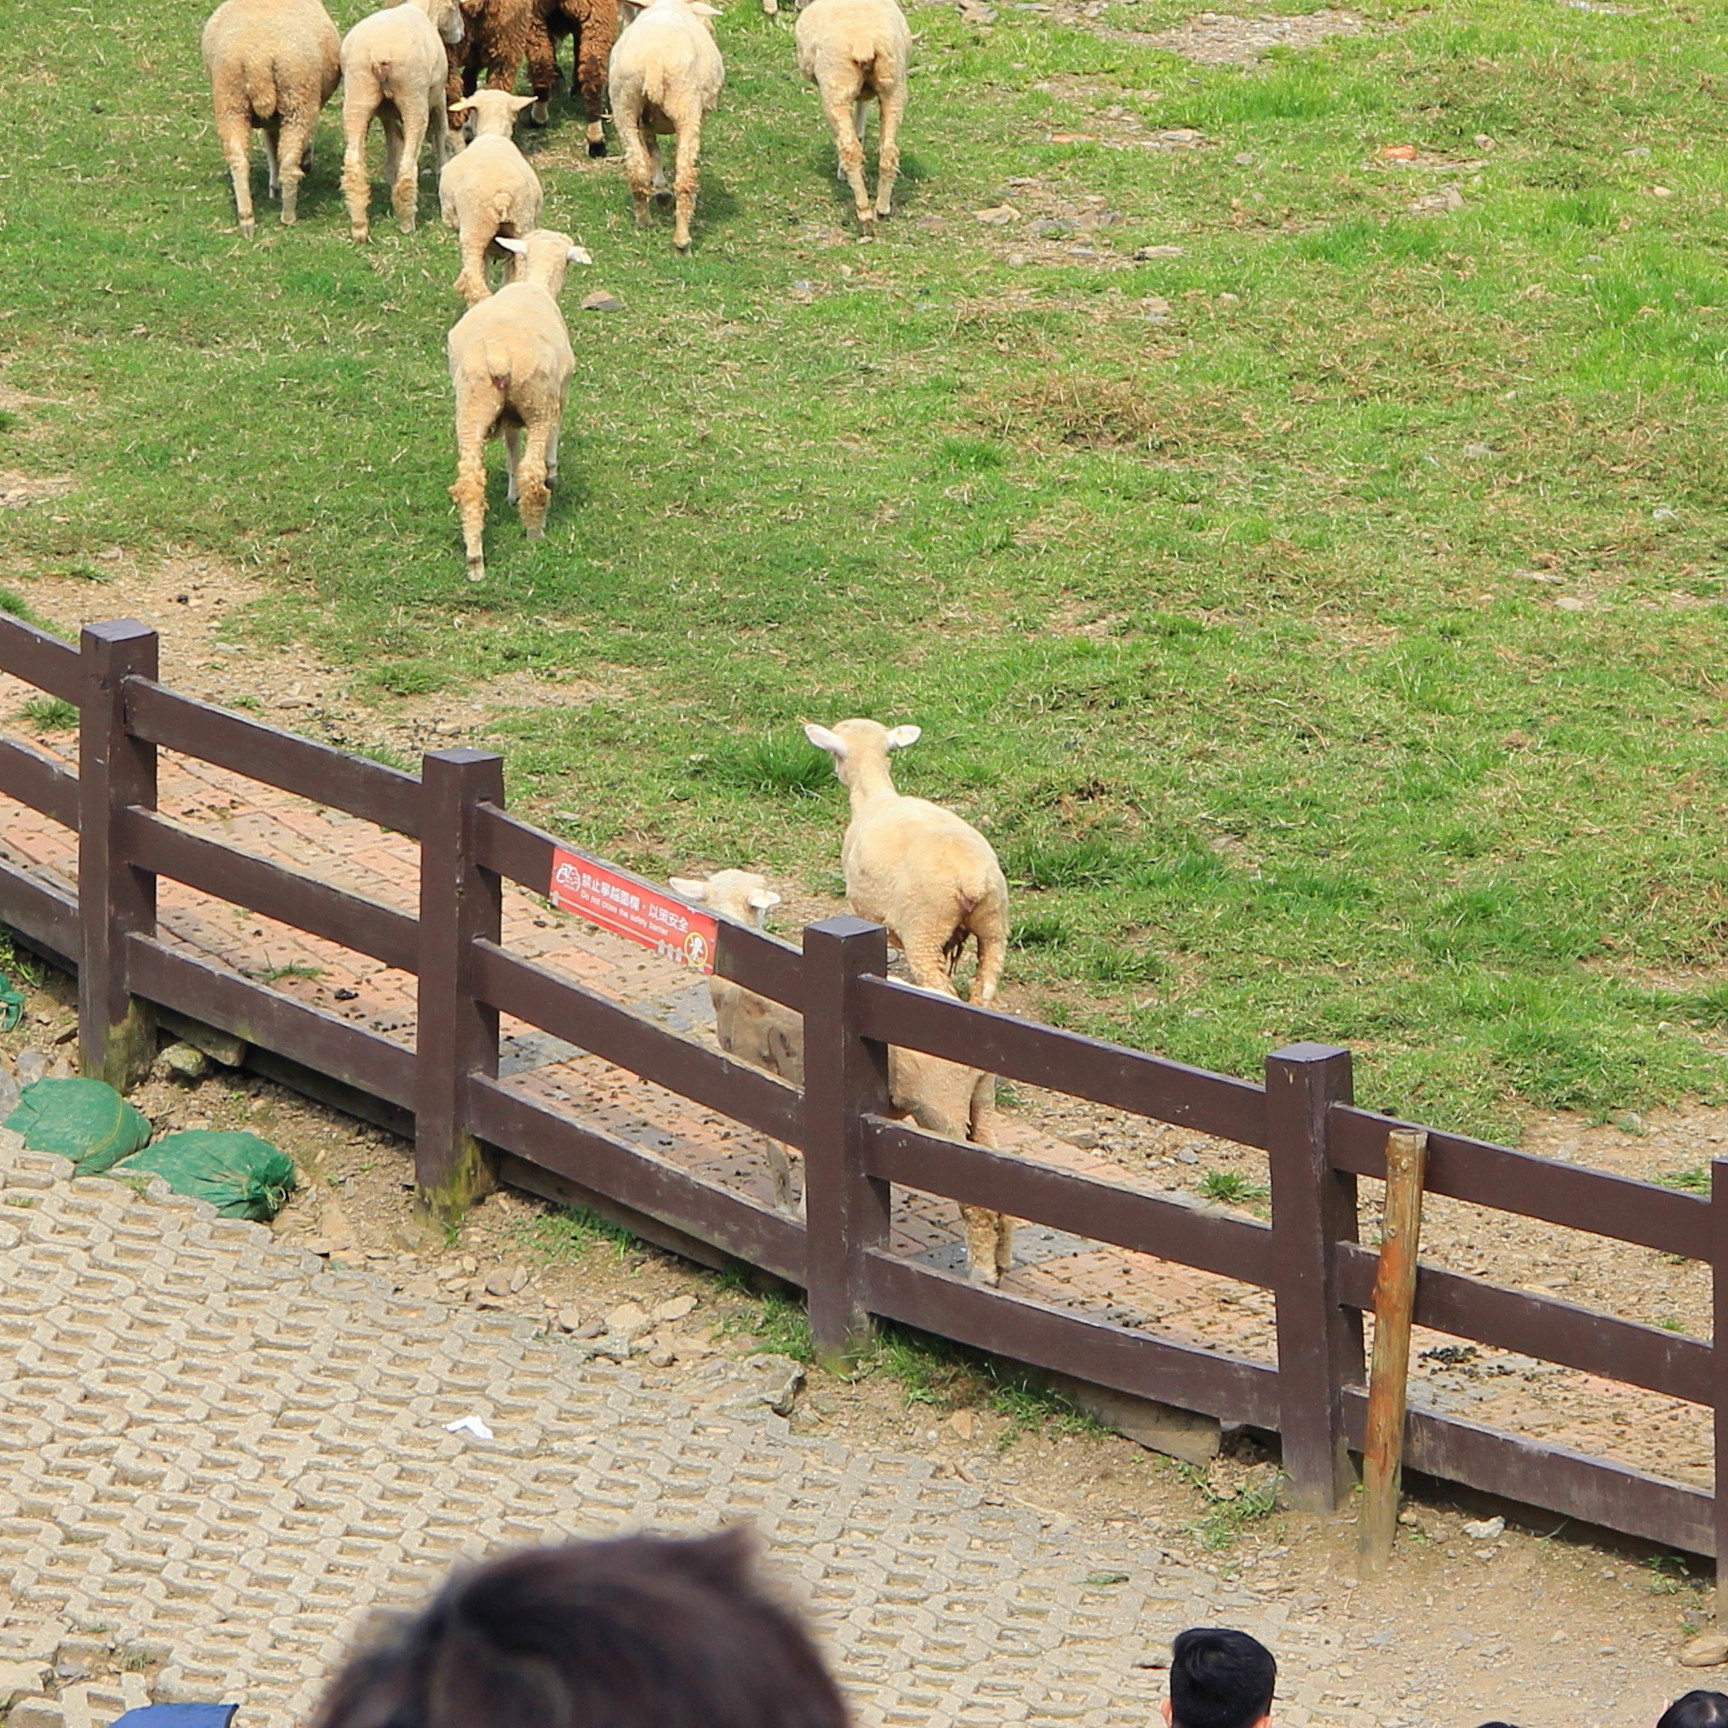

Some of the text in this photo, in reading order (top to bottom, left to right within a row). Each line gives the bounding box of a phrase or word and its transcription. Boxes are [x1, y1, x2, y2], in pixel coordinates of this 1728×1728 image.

[580, 889, 590, 901] Do
[601, 901, 618, 914] cross
[619, 908, 629, 919] the
[630, 914, 648, 928] safety
